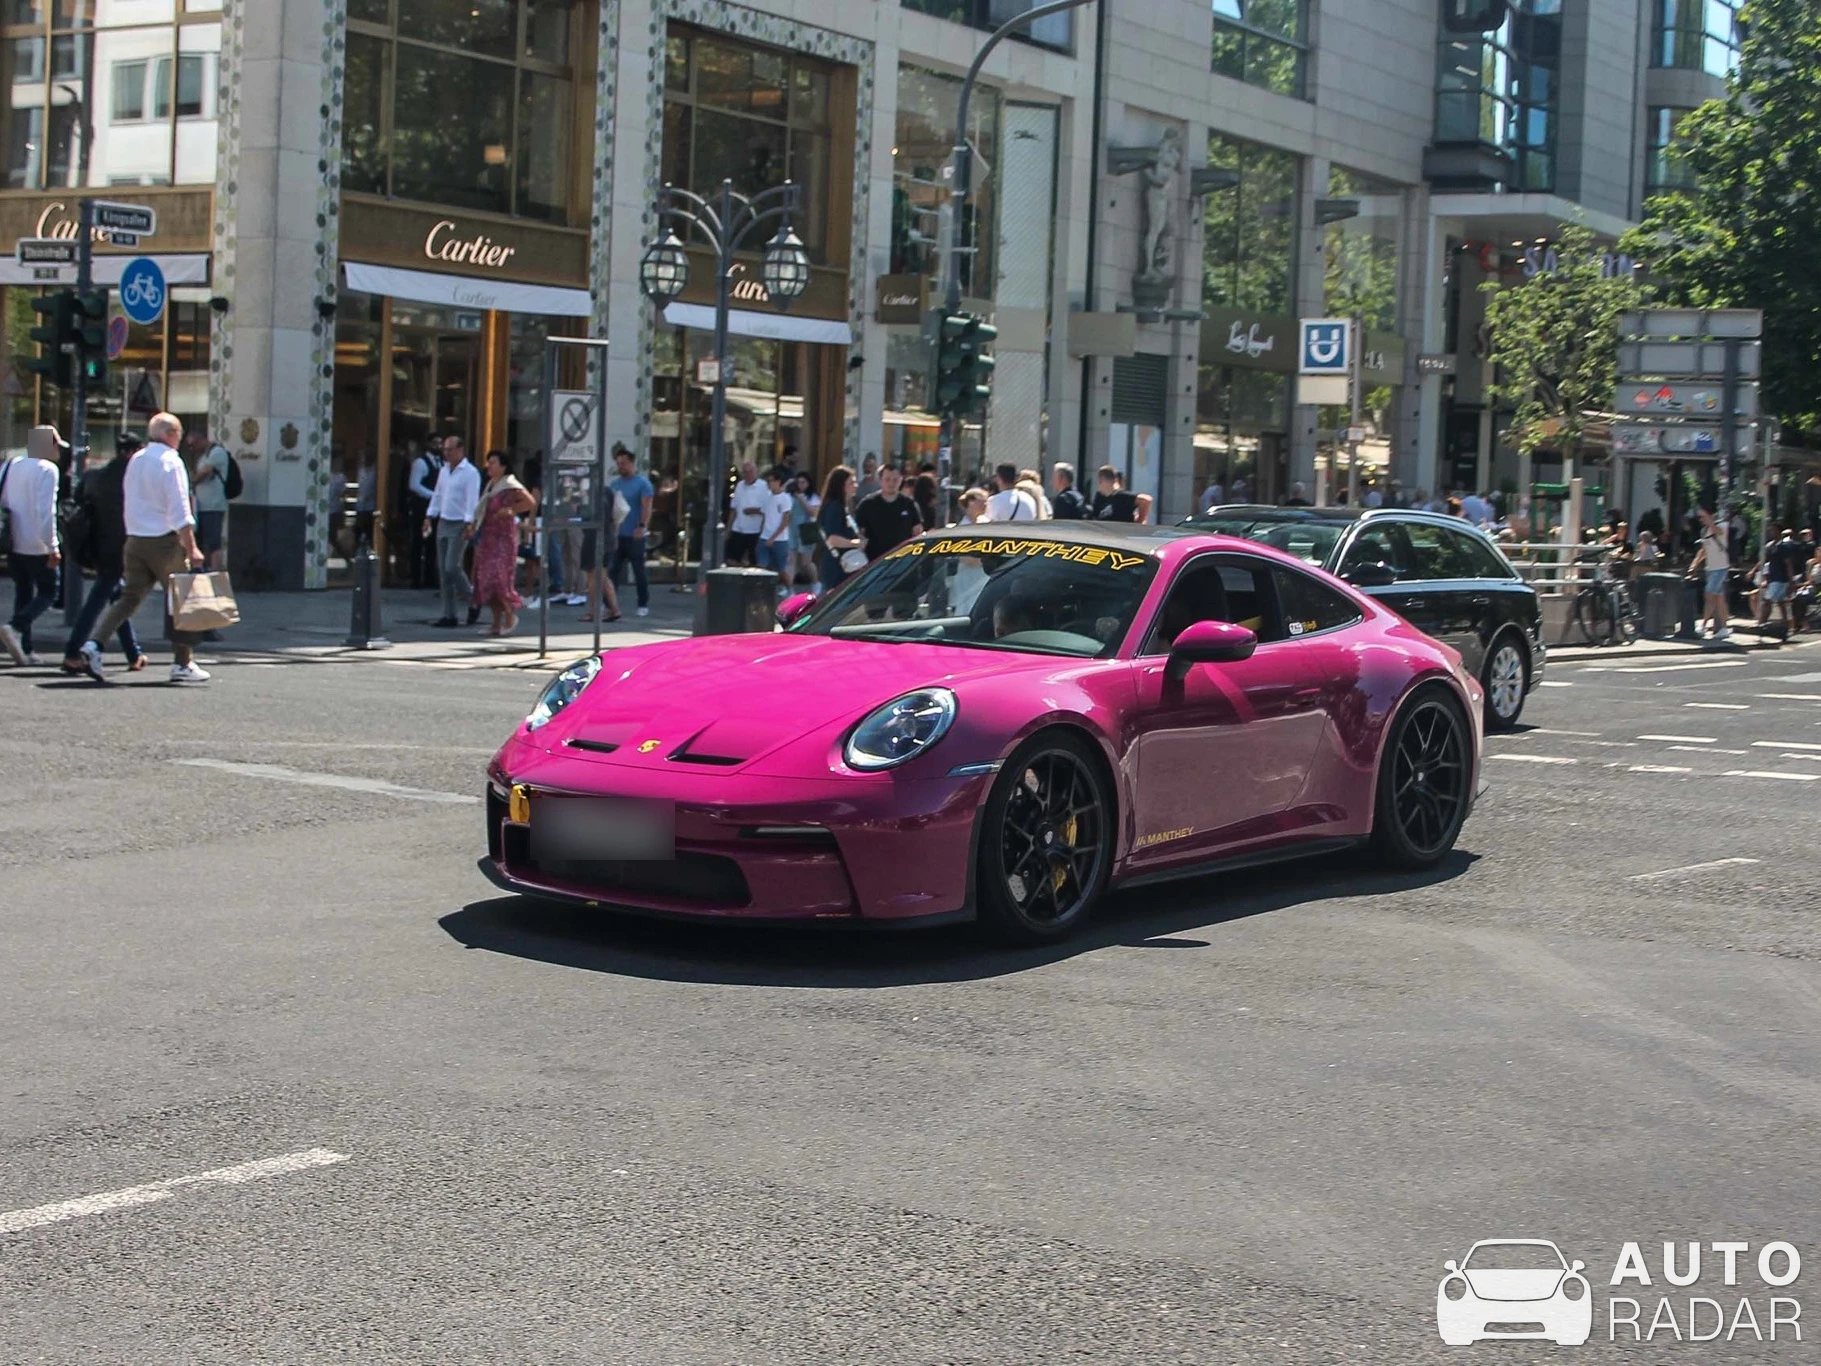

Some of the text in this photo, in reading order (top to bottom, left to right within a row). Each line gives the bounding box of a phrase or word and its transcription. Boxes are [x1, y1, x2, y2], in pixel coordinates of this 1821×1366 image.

[424, 220, 515, 267] Cartier
[882, 292, 918, 305] Cartier
[928, 540, 1144, 571] MANTHEY
[1147, 826, 1194, 844] MANTHEY
